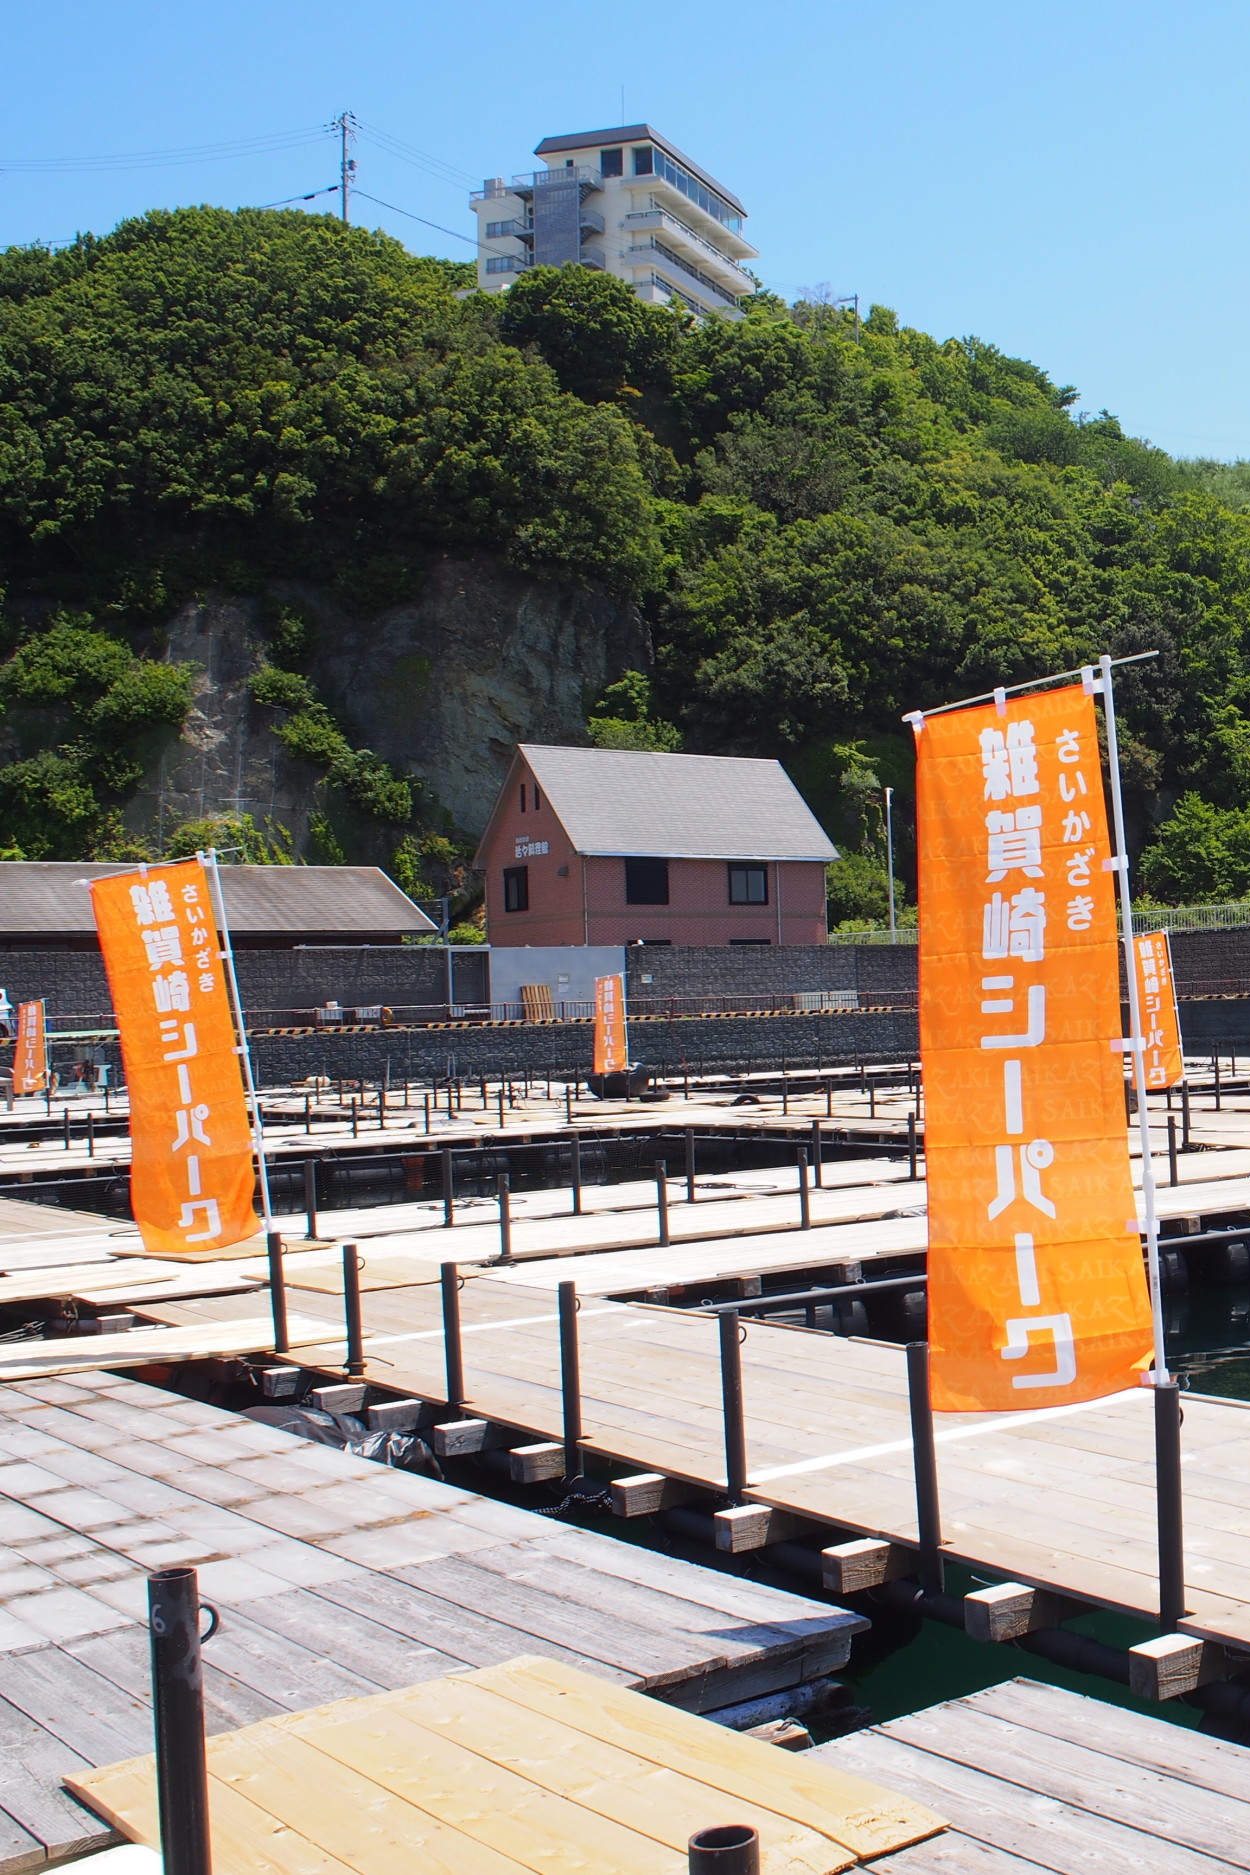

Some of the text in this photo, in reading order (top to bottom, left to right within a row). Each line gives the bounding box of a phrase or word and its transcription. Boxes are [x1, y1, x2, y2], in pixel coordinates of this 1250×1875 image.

[1055, 729, 1094, 930] さいかざき
[180, 884, 215, 993] さいかざき
[1138, 940, 1166, 1085] 雑賀崎シーパーク
[129, 880, 221, 1242] 雑賀崎シーパーク
[979, 720, 1076, 1389] 雑賀崎シーパーク
[152, 1604, 166, 1633] 6
